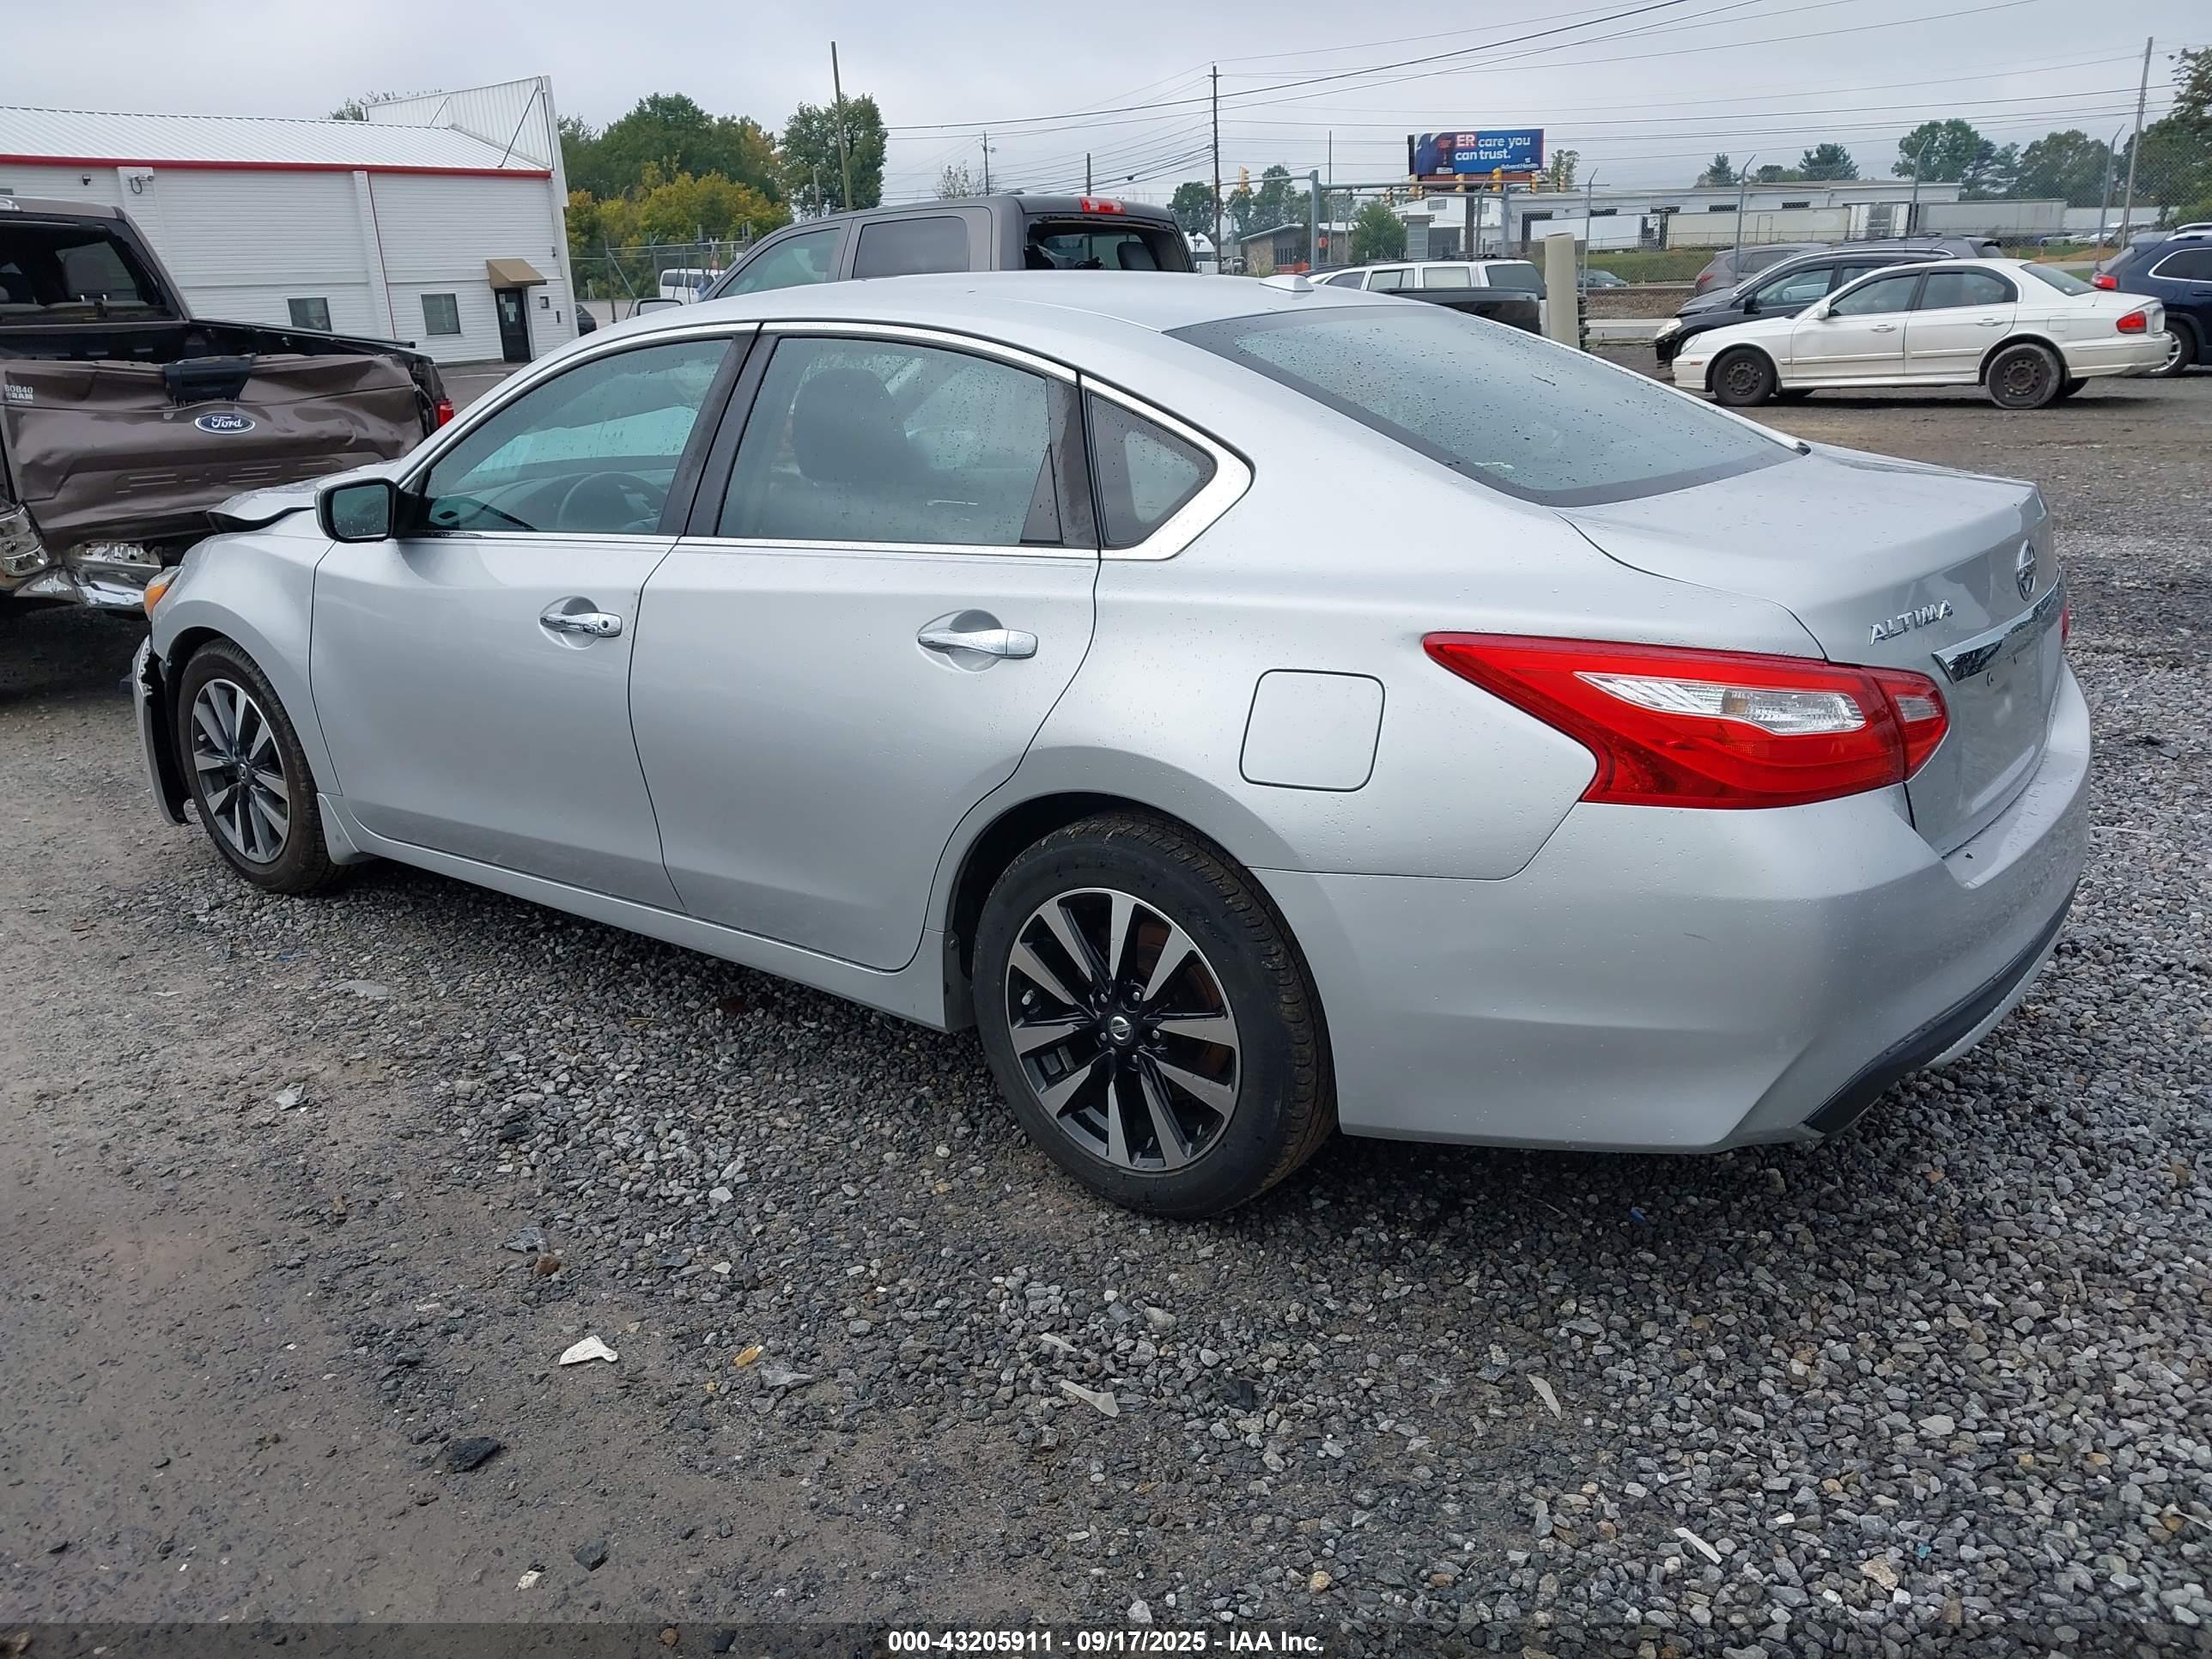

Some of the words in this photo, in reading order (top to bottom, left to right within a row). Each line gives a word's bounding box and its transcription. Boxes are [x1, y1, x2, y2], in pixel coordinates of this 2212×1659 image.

[1455, 134, 1475, 147] ER
[1478, 137, 1504, 148] care
[1508, 137, 1531, 149] you
[1455, 151, 1477, 161] can
[1479, 149, 1511, 160] trust.
[210, 416, 243, 429] Ford
[1869, 599, 1954, 646] ALTIMA
